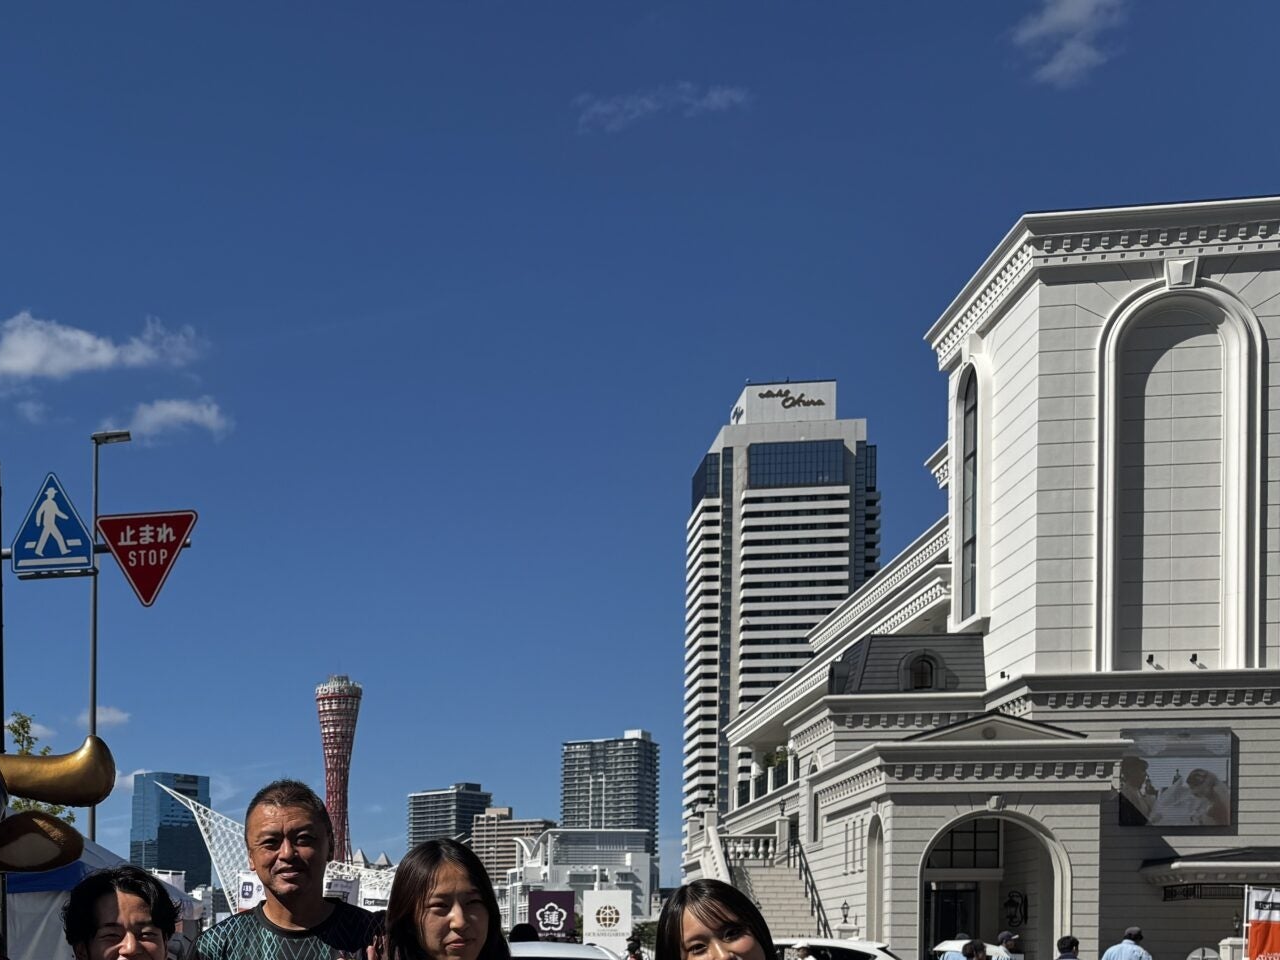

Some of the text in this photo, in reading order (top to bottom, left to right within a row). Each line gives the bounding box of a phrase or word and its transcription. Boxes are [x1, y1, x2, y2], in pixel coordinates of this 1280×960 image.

[117, 523, 177, 547] 止まれ
[128, 549, 169, 568] STOP
